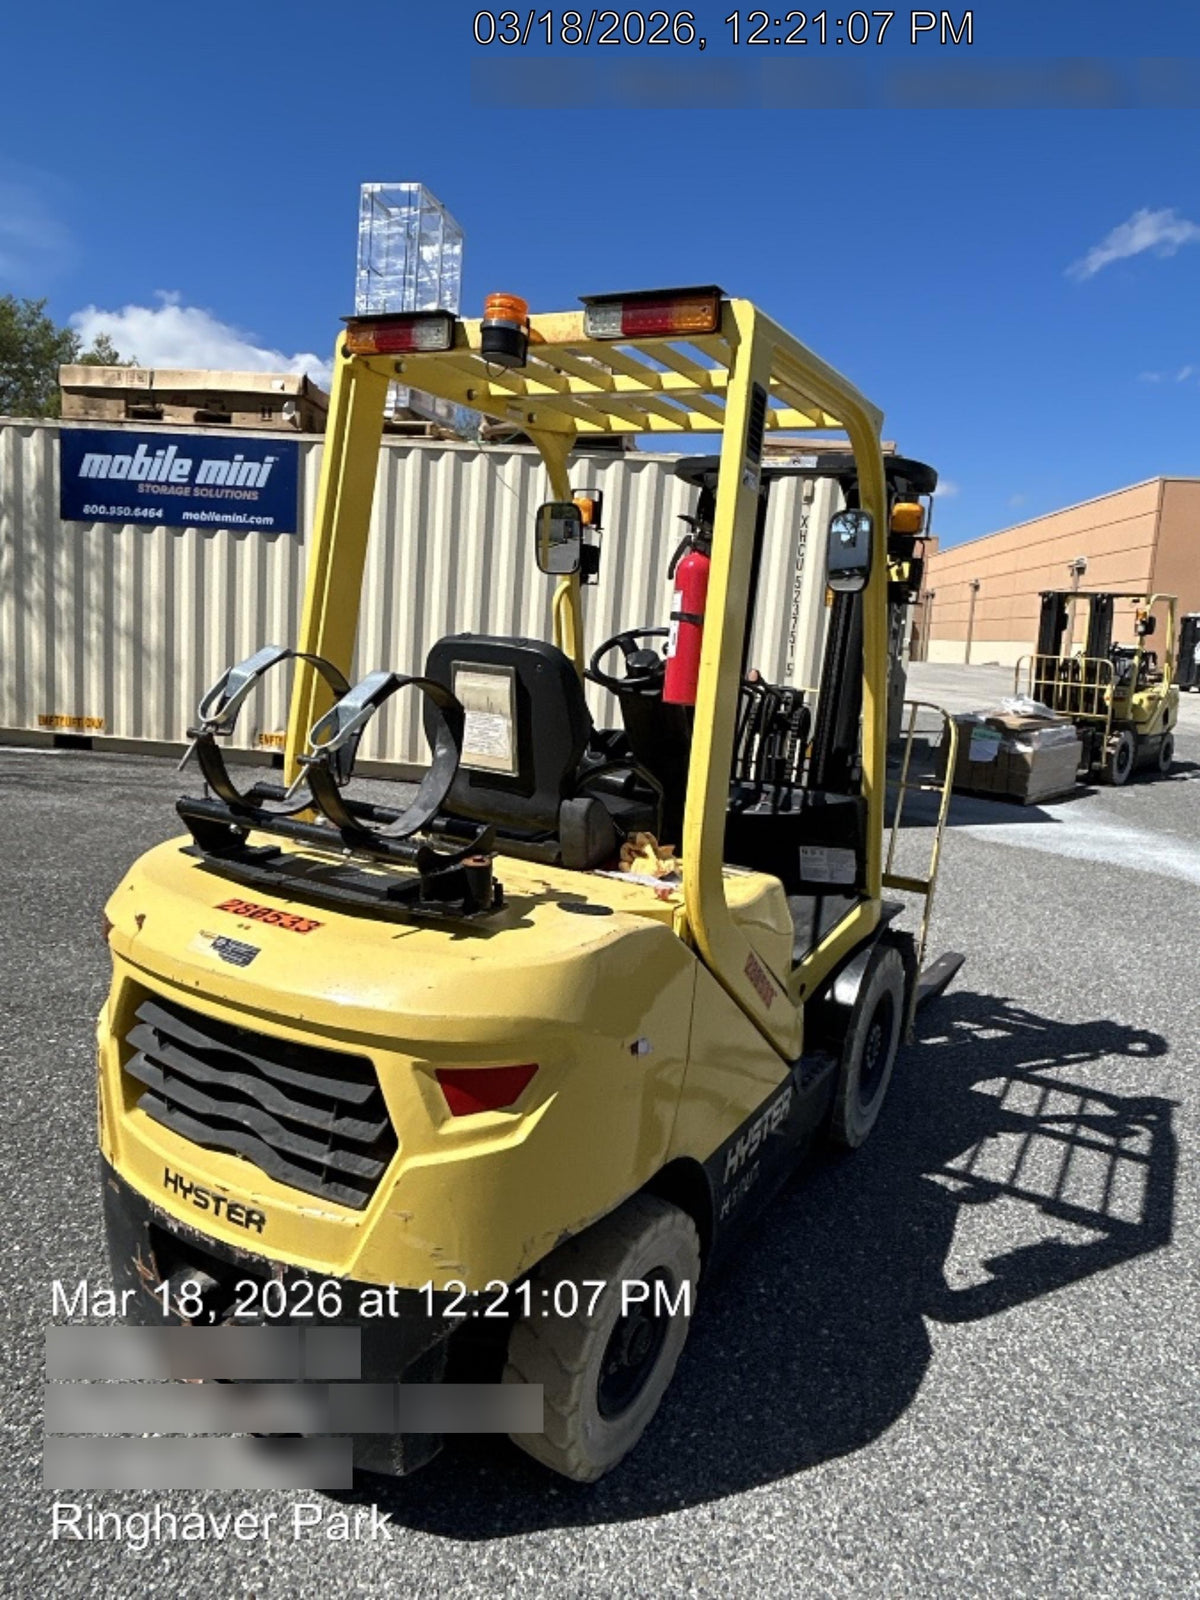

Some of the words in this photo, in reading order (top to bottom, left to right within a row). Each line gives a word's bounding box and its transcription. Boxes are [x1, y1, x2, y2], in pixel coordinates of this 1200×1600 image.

[78, 443, 193, 483] mobile
[195, 454, 273, 488] mini
[83, 504, 164, 519] 800.950.6464
[183, 511, 273, 525] mobilemini.com
[137, 483, 191, 497] STORAGE
[192, 487, 259, 501] SOLUTIONS
[796, 515, 810, 571] XHCU
[213, 898, 322, 934] 280533
[723, 1086, 793, 1184] HYSTER
[164, 1167, 266, 1234] HYSTER
